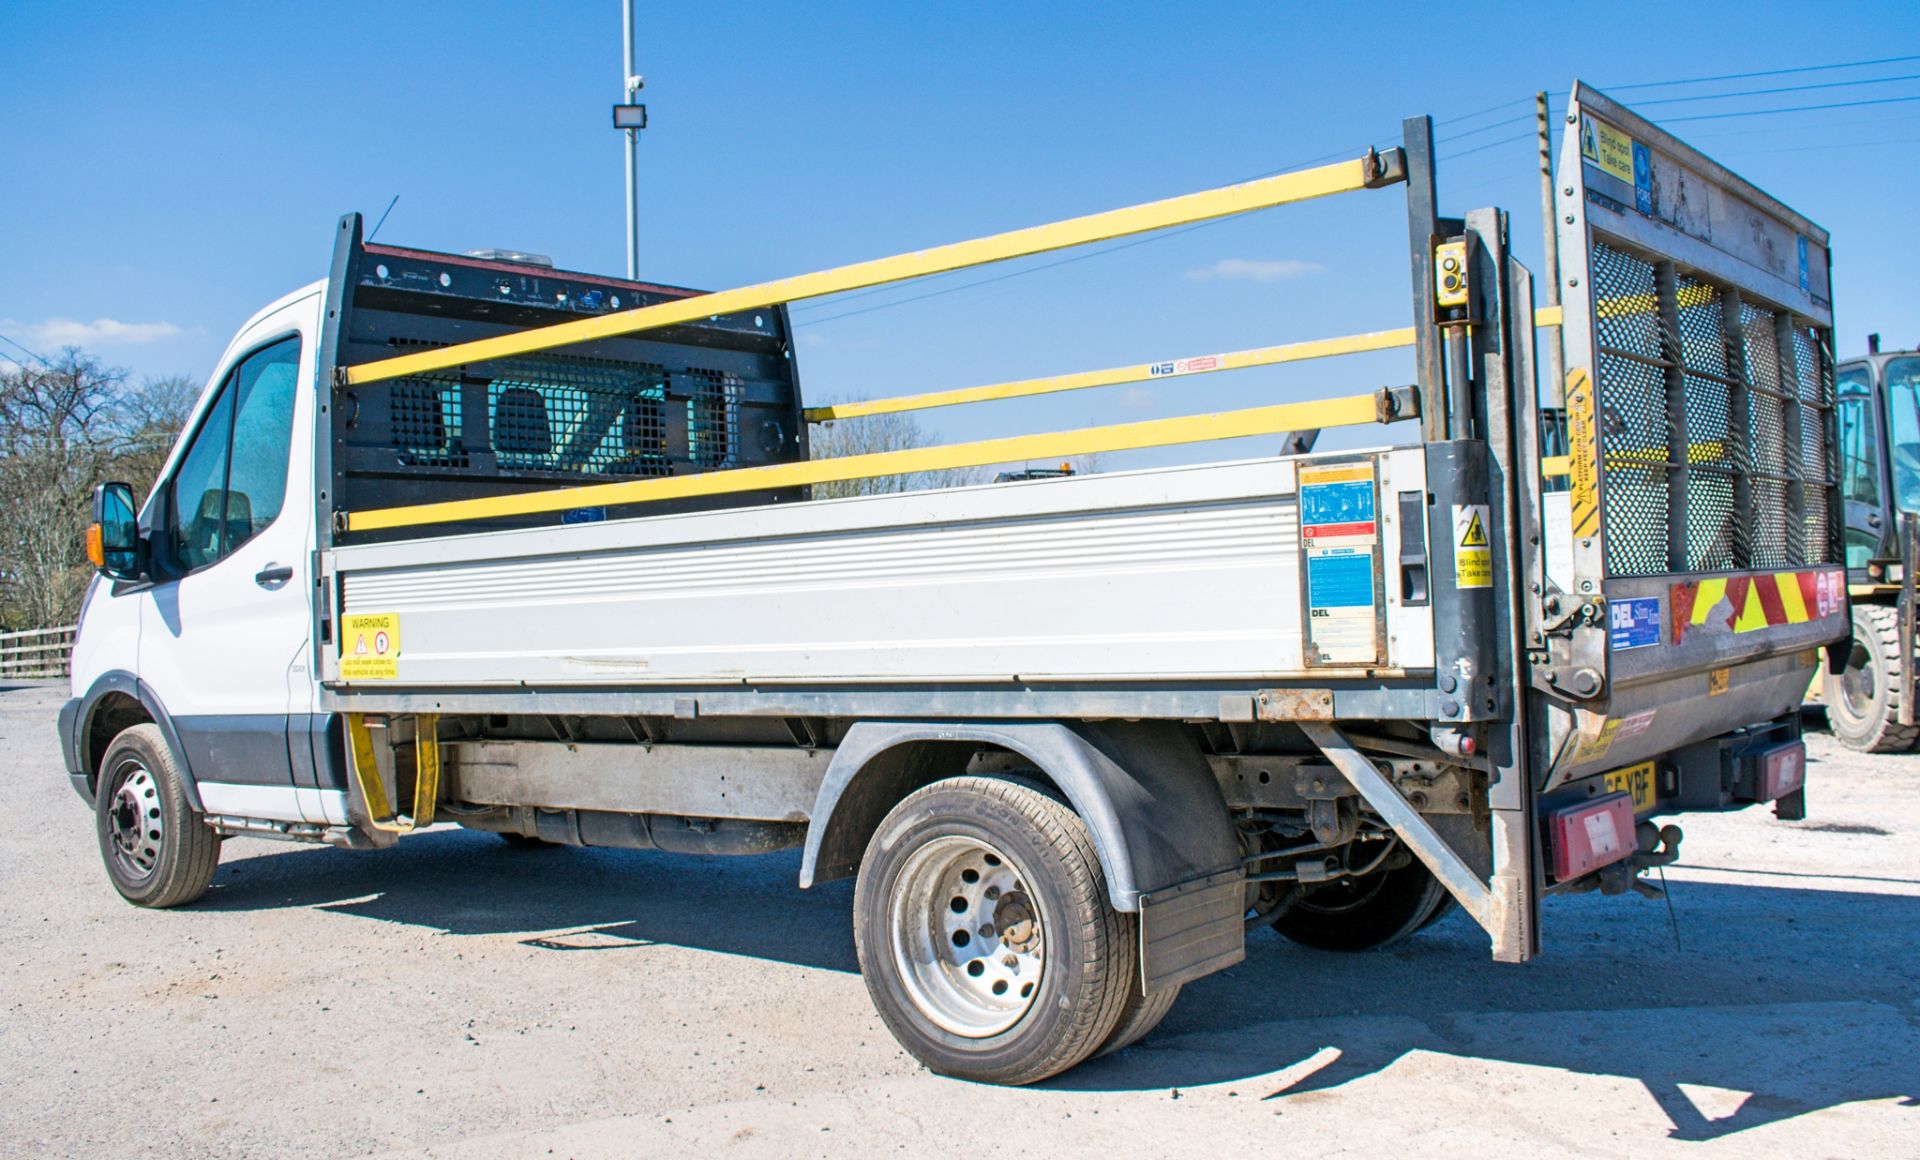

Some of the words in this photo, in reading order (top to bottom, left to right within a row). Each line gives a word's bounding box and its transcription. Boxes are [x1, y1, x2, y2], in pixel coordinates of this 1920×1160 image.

[1602, 149, 1617, 168] Take
[1303, 538, 1314, 547] DEL
[1459, 558, 1480, 566] Blind
[1312, 609, 1330, 617] DEL
[1612, 603, 1635, 629] DEL
[352, 617, 390, 628] WARNING
